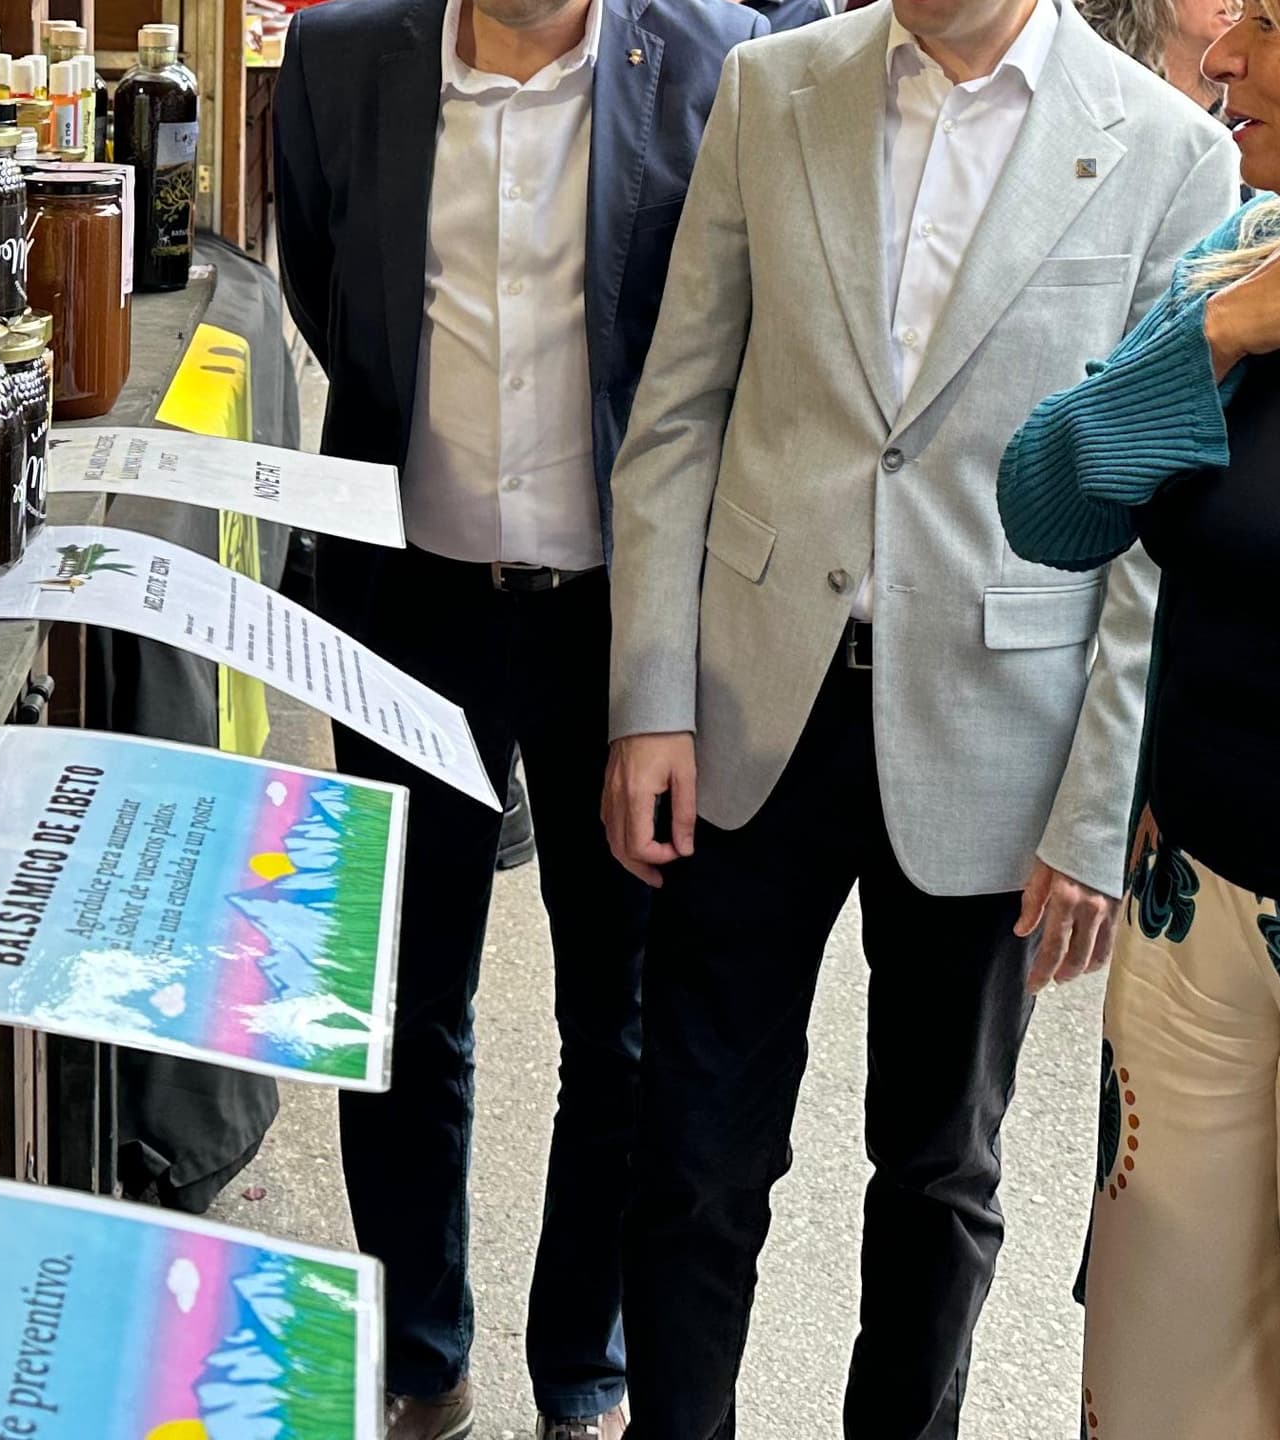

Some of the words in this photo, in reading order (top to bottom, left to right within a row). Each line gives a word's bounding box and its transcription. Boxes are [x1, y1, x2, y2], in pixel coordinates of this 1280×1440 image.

[253, 461, 281, 502] NOVETAT
[45, 764, 105, 819] ABETO
[104, 798, 141, 851] aumentar
[142, 801, 178, 836] platos.
[188, 795, 217, 832] postre.
[33, 820, 81, 846] DE
[186, 831, 208, 847] un
[96, 851, 125, 879] para
[135, 836, 167, 883] vuestros
[182, 847, 200, 857] a
[120, 884, 150, 901] de
[163, 857, 199, 907] ensalada
[65, 877, 111, 940] Agridulce
[109, 901, 144, 938] sabor
[158, 908, 183, 932] una
[7, 1254, 74, 1413] preventivo.
